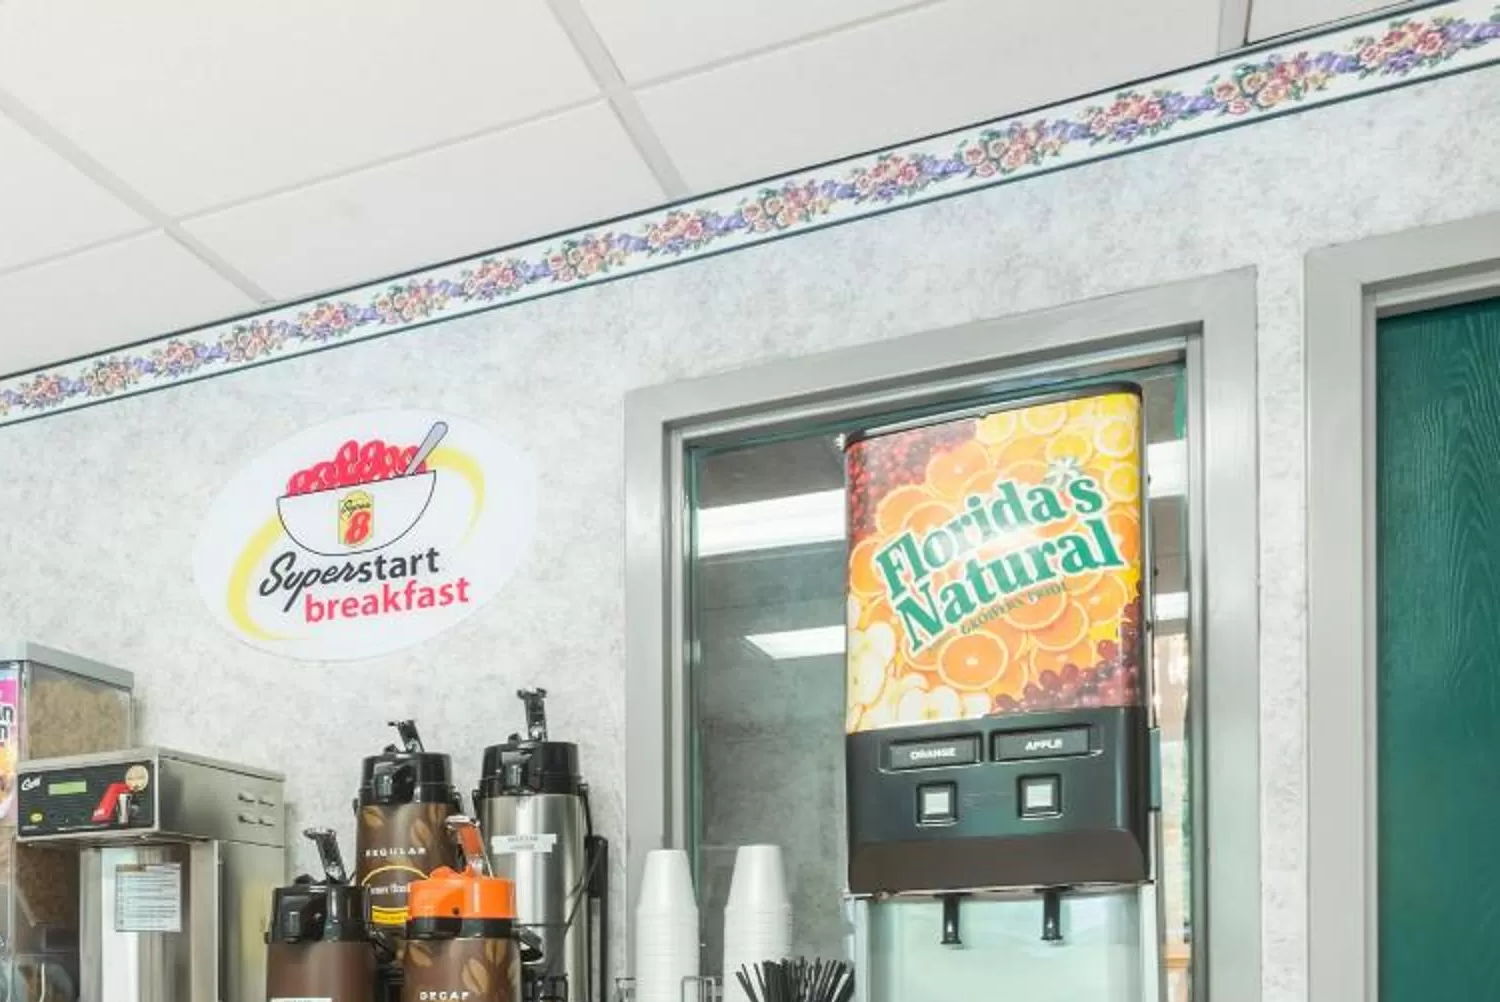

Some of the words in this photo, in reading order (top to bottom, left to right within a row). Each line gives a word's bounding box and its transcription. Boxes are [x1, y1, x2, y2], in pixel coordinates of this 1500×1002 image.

[345, 510, 371, 545] 8
[873, 472, 1105, 602] Florida's
[259, 547, 439, 613] Superstart
[895, 517, 1126, 654] Natural
[304, 577, 470, 623] breakfast
[909, 747, 958, 760] ORANGE
[1025, 738, 1063, 751] APPLE
[365, 847, 426, 857] REGULAR
[420, 991, 469, 1001] DECAF
